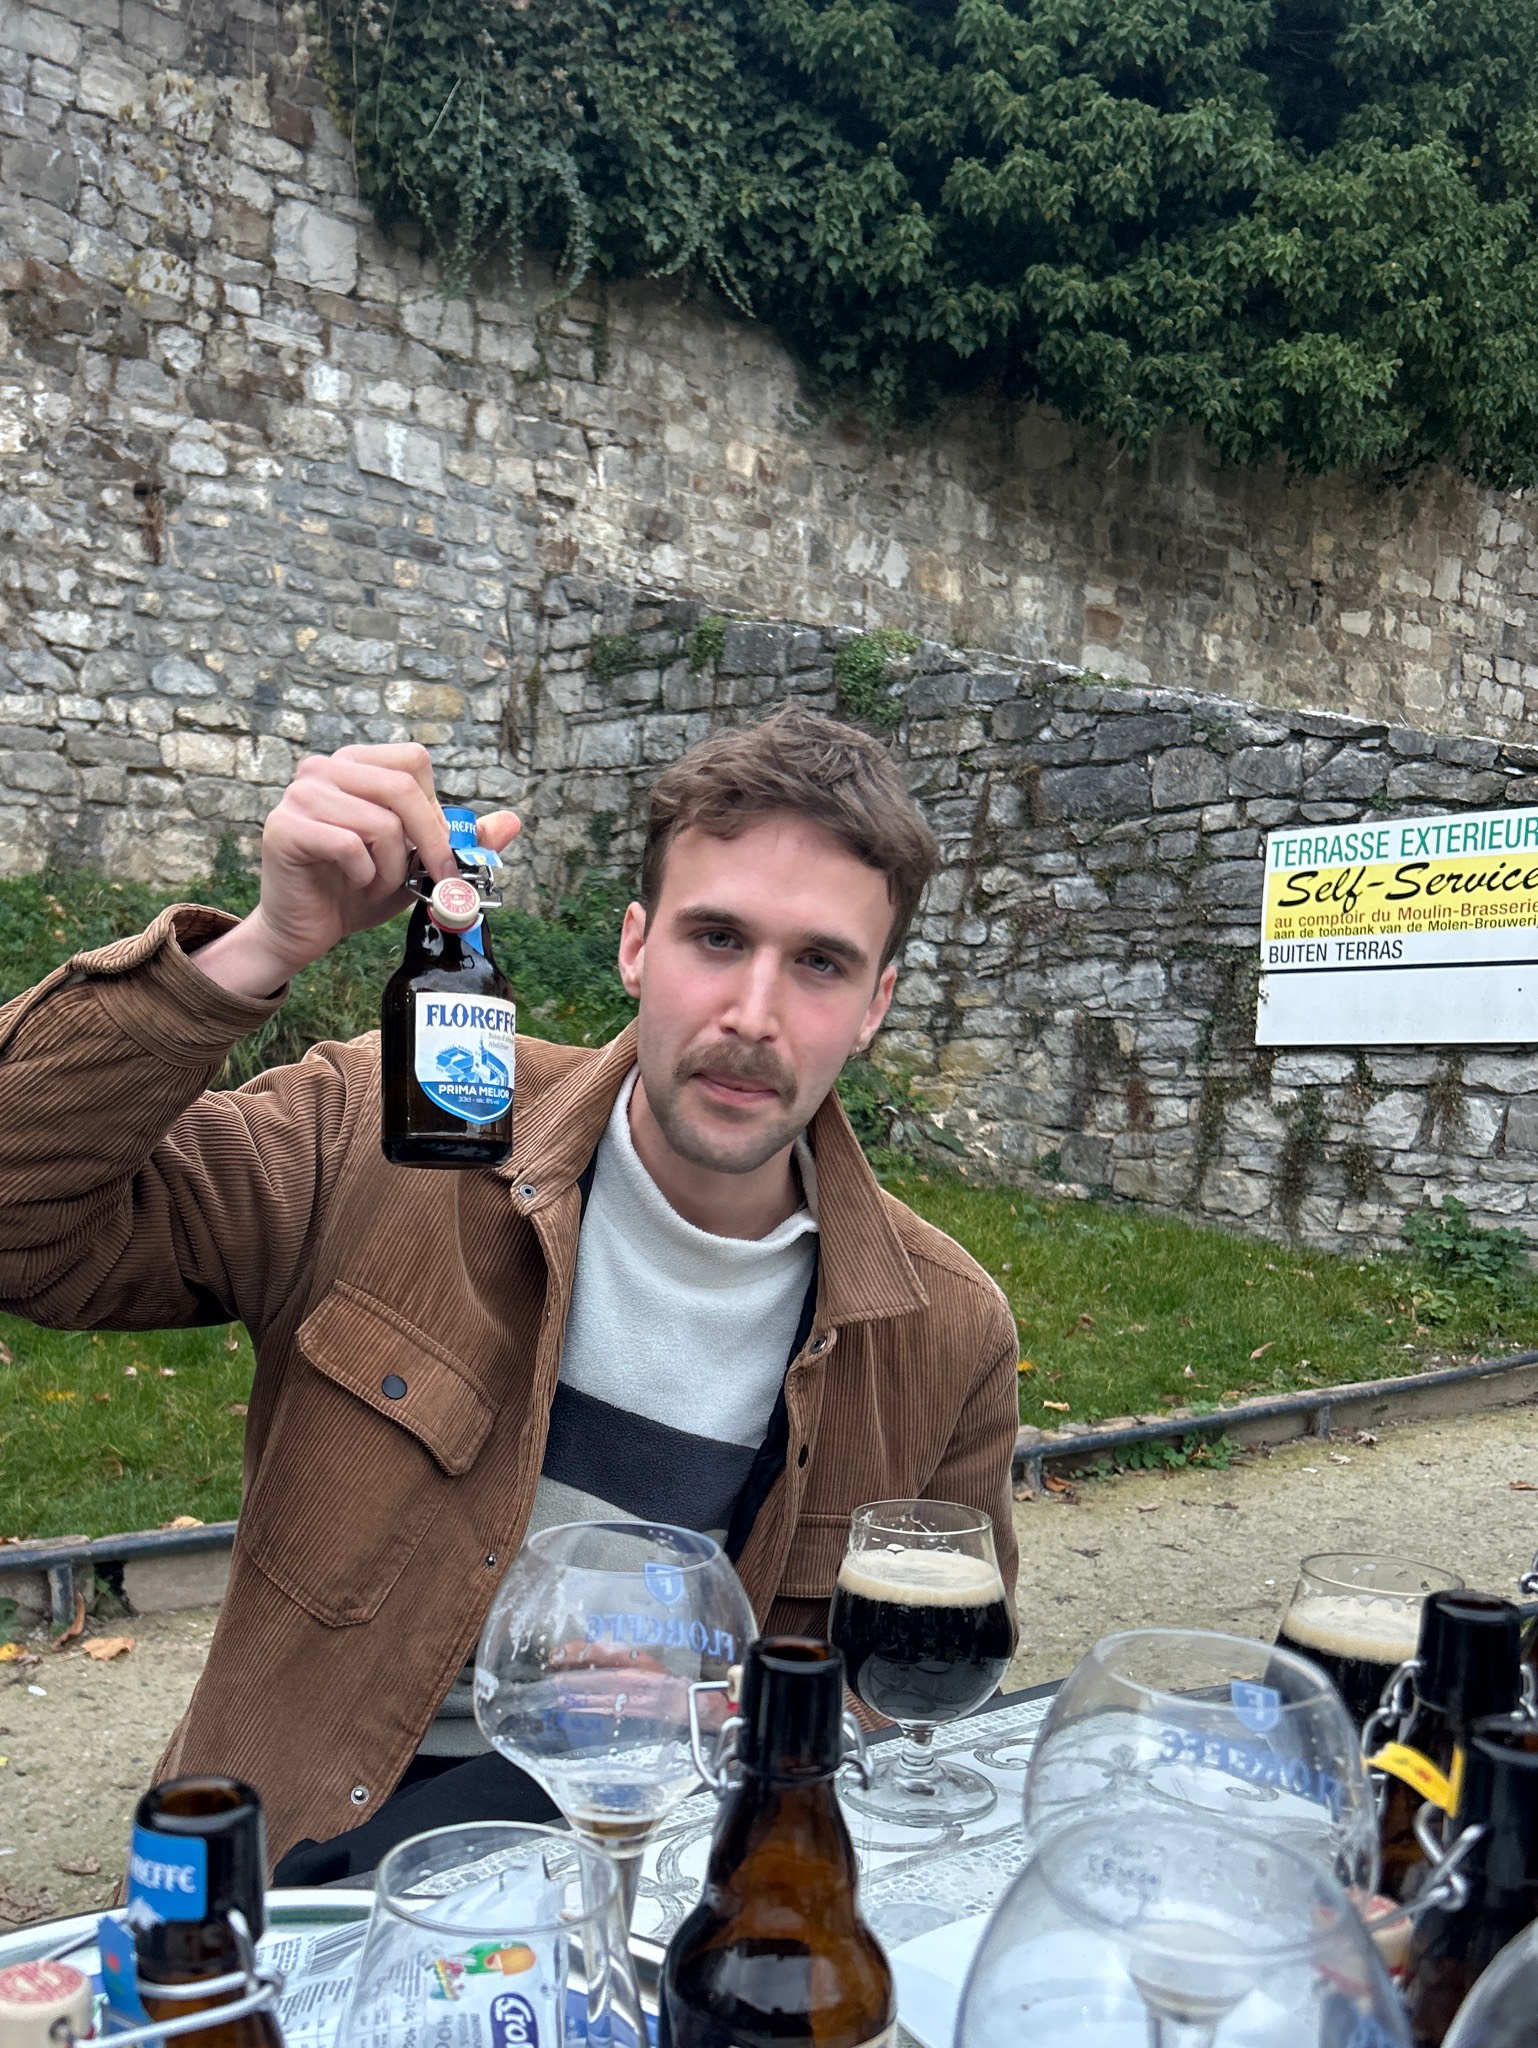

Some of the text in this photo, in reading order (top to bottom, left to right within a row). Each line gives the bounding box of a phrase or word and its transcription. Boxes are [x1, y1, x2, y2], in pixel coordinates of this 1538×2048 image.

[1271, 816, 1538, 868] TERRASSE EXTERIEUR
[1277, 862, 1538, 914] Self-Service
[1273, 915, 1538, 940] aan de toonbank van de Molen-Brouweri
[1274, 917, 1292, 929] au
[1298, 910, 1365, 928] comptoir
[1371, 909, 1390, 923] du
[1269, 939, 1403, 964] BUITEN TERRAS
[438, 1084, 510, 1100] PRIMA MELIOR
